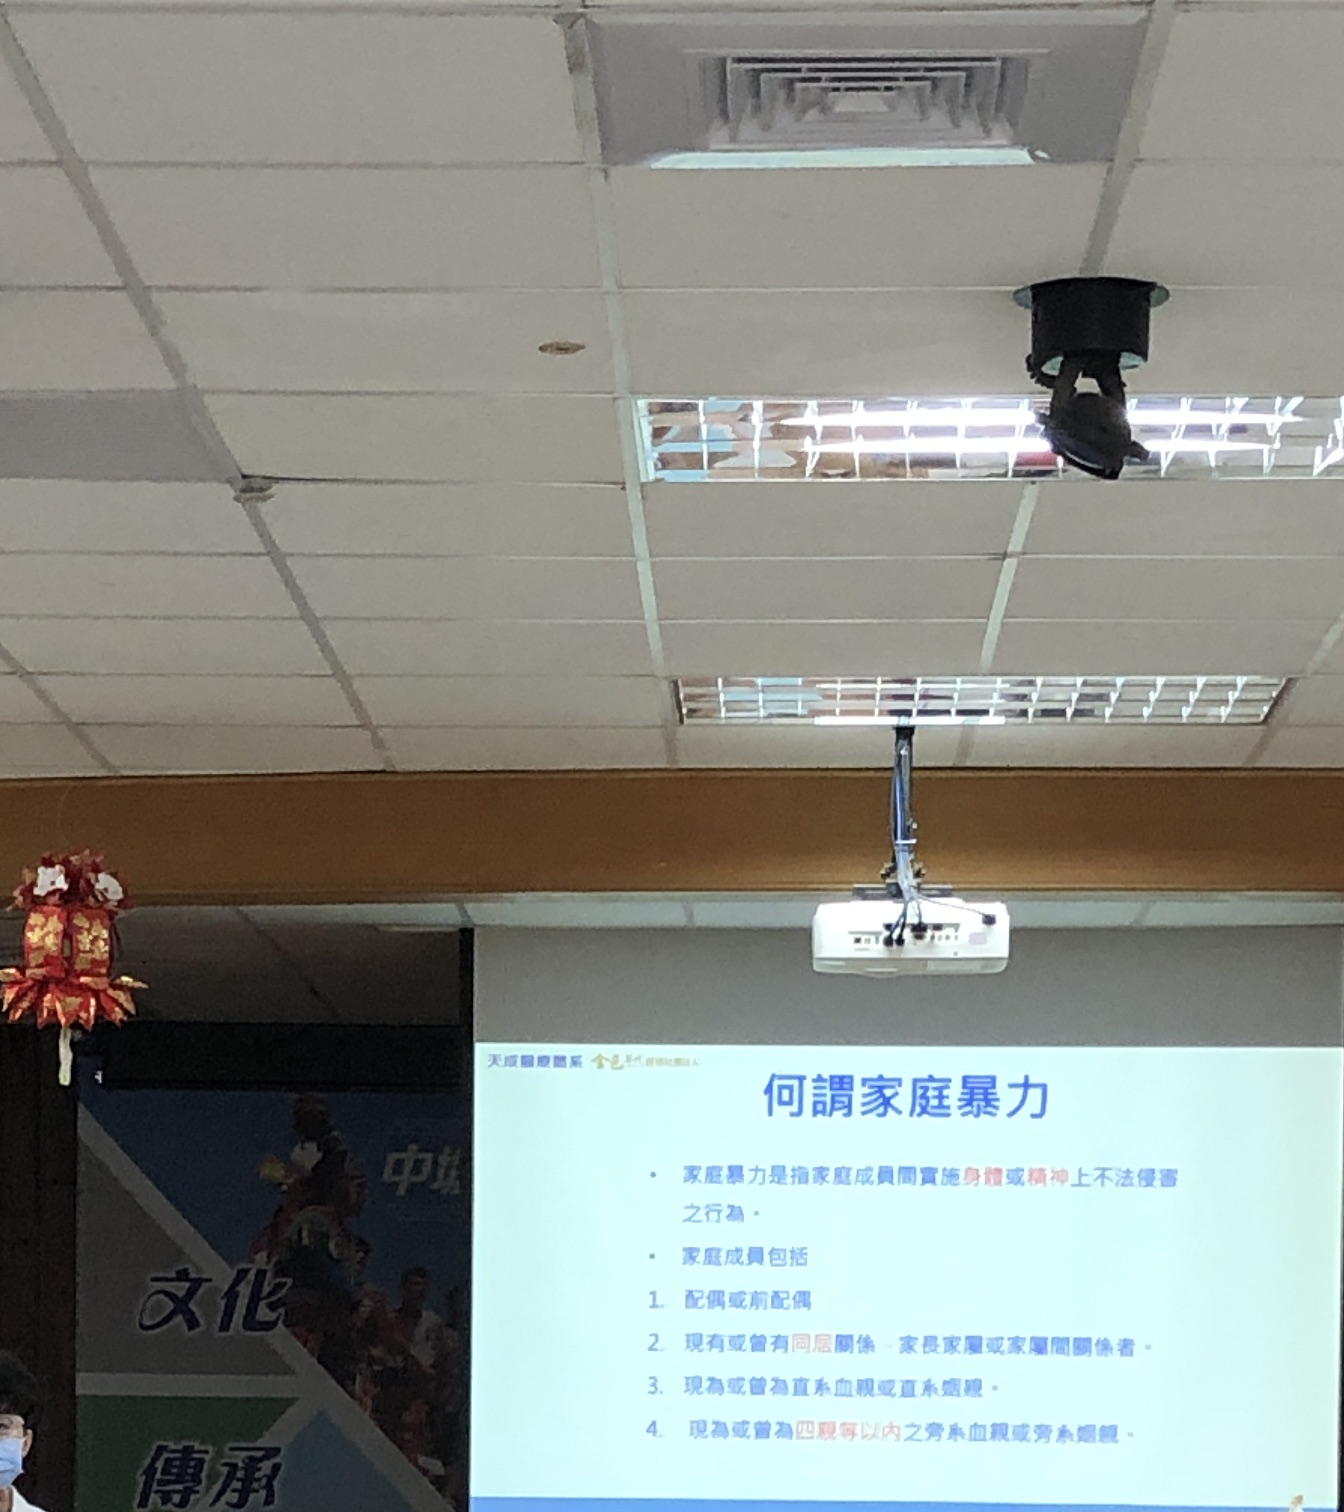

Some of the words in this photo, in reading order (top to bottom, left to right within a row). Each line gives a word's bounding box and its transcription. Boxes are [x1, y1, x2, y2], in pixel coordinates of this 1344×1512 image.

[762, 1073, 1050, 1120] 何謂家庭暴力
[681, 1246, 809, 1268] 家庭成員包括
[138, 1266, 292, 1334] 文化
[684, 1289, 813, 1311] 配偶或前配偶
[135, 1443, 283, 1511] 傳承
